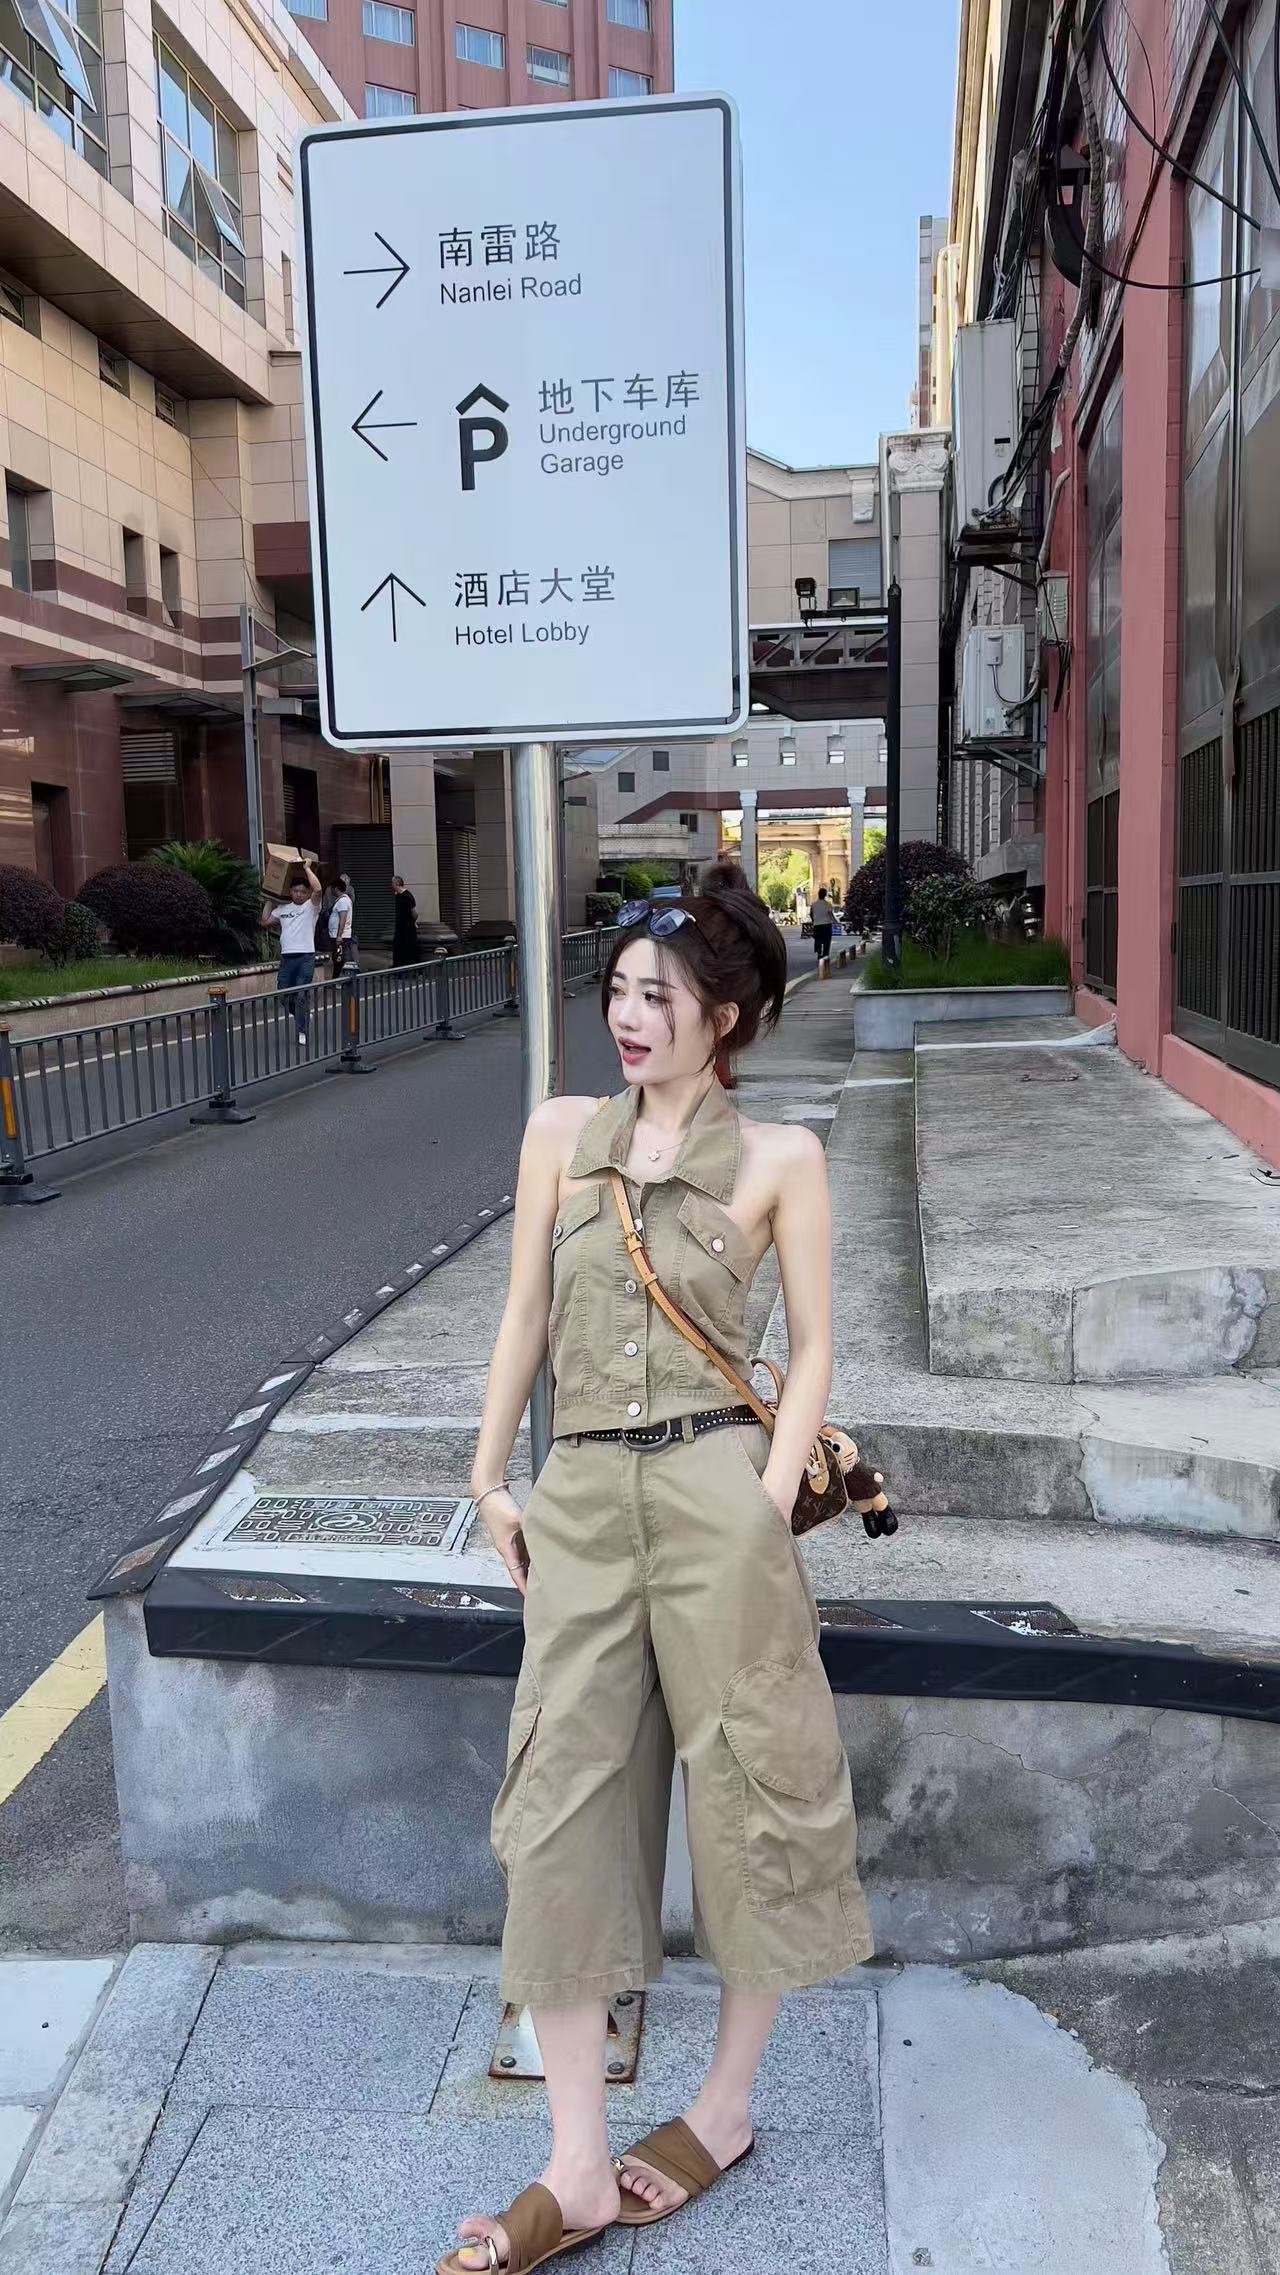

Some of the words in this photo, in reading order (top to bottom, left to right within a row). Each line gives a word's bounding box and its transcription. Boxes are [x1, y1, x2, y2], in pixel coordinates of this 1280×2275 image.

[439, 220, 561, 269] 南雷路
[441, 278, 512, 305] Nanlei
[521, 273, 582, 299] Road
[538, 370, 700, 415] 地下车库
[540, 415, 686, 445] Underground
[459, 416, 509, 491] P
[541, 453, 624, 476] Garage
[454, 565, 616, 608] 酒店大堂
[456, 624, 513, 646] Hotel
[522, 621, 590, 645] Lobby
